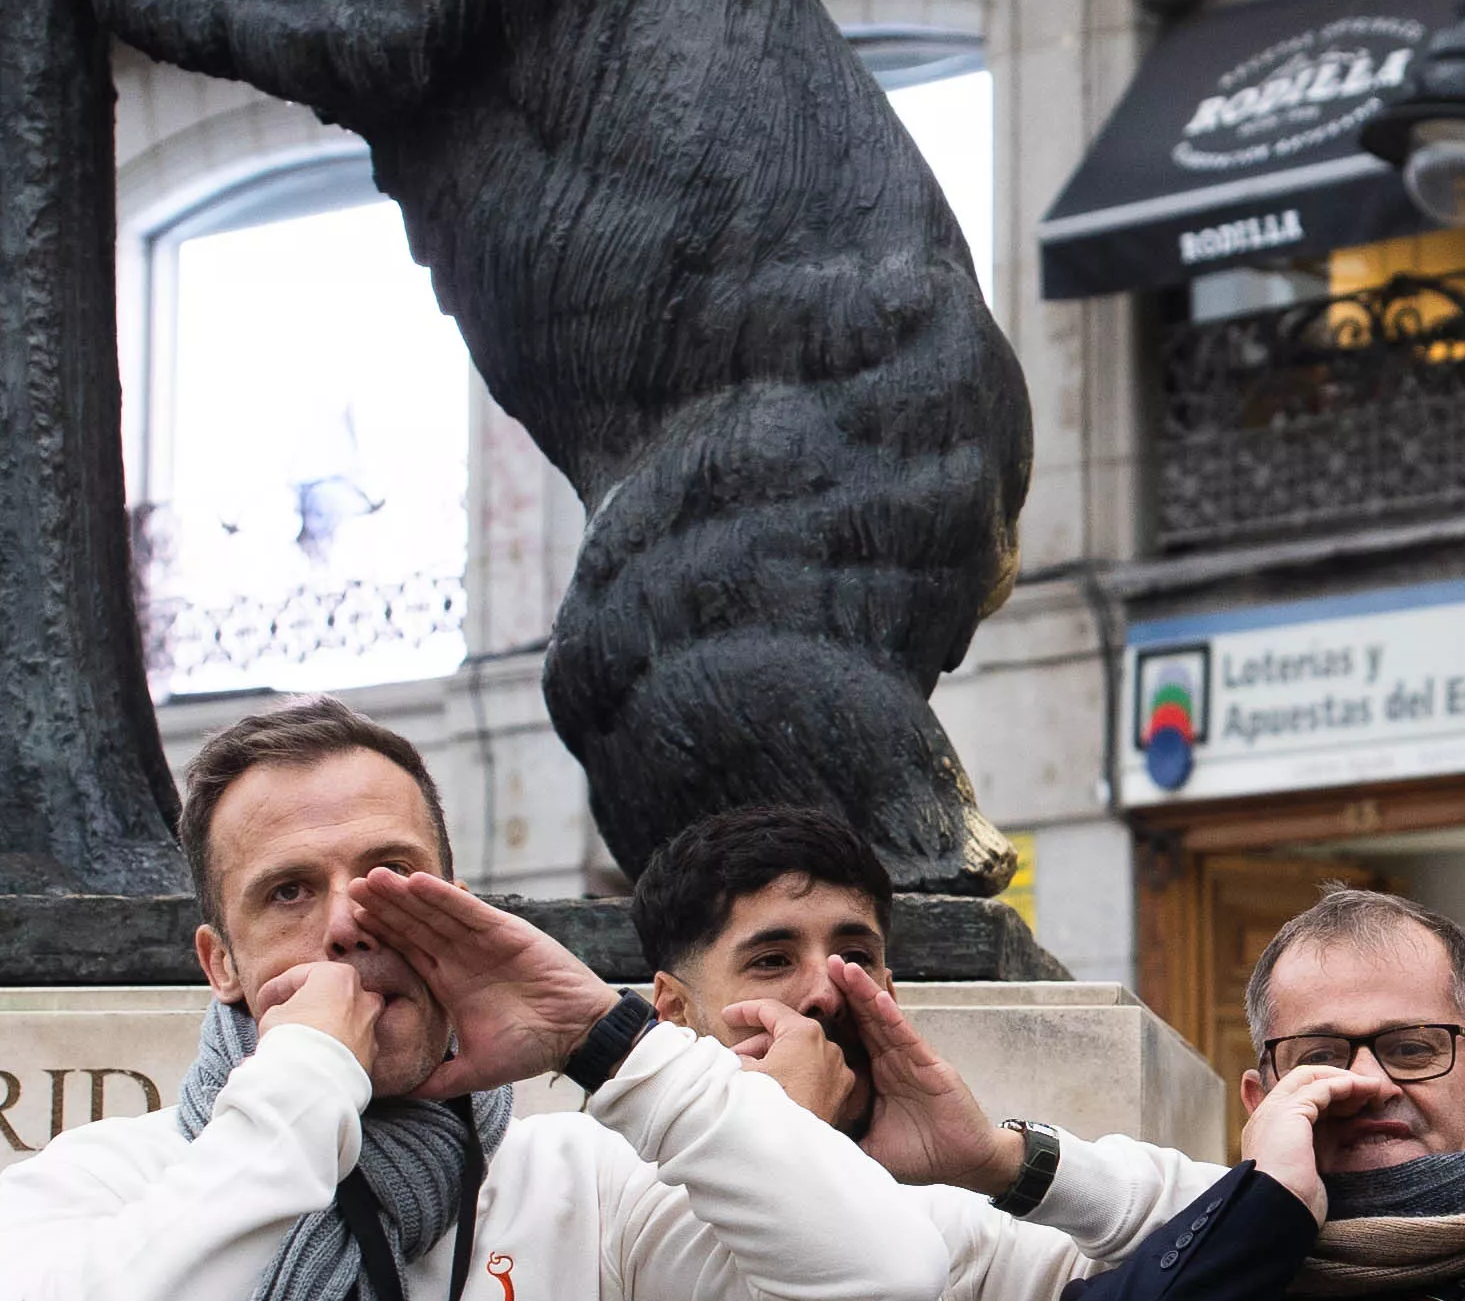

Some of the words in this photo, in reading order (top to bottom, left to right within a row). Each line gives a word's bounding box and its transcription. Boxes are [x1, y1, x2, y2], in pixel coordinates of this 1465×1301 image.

[1179, 208, 1304, 265] RODILLA
[1365, 645, 1384, 685] y
[1223, 694, 1373, 747] Apuestas
[1386, 677, 1435, 722] del
